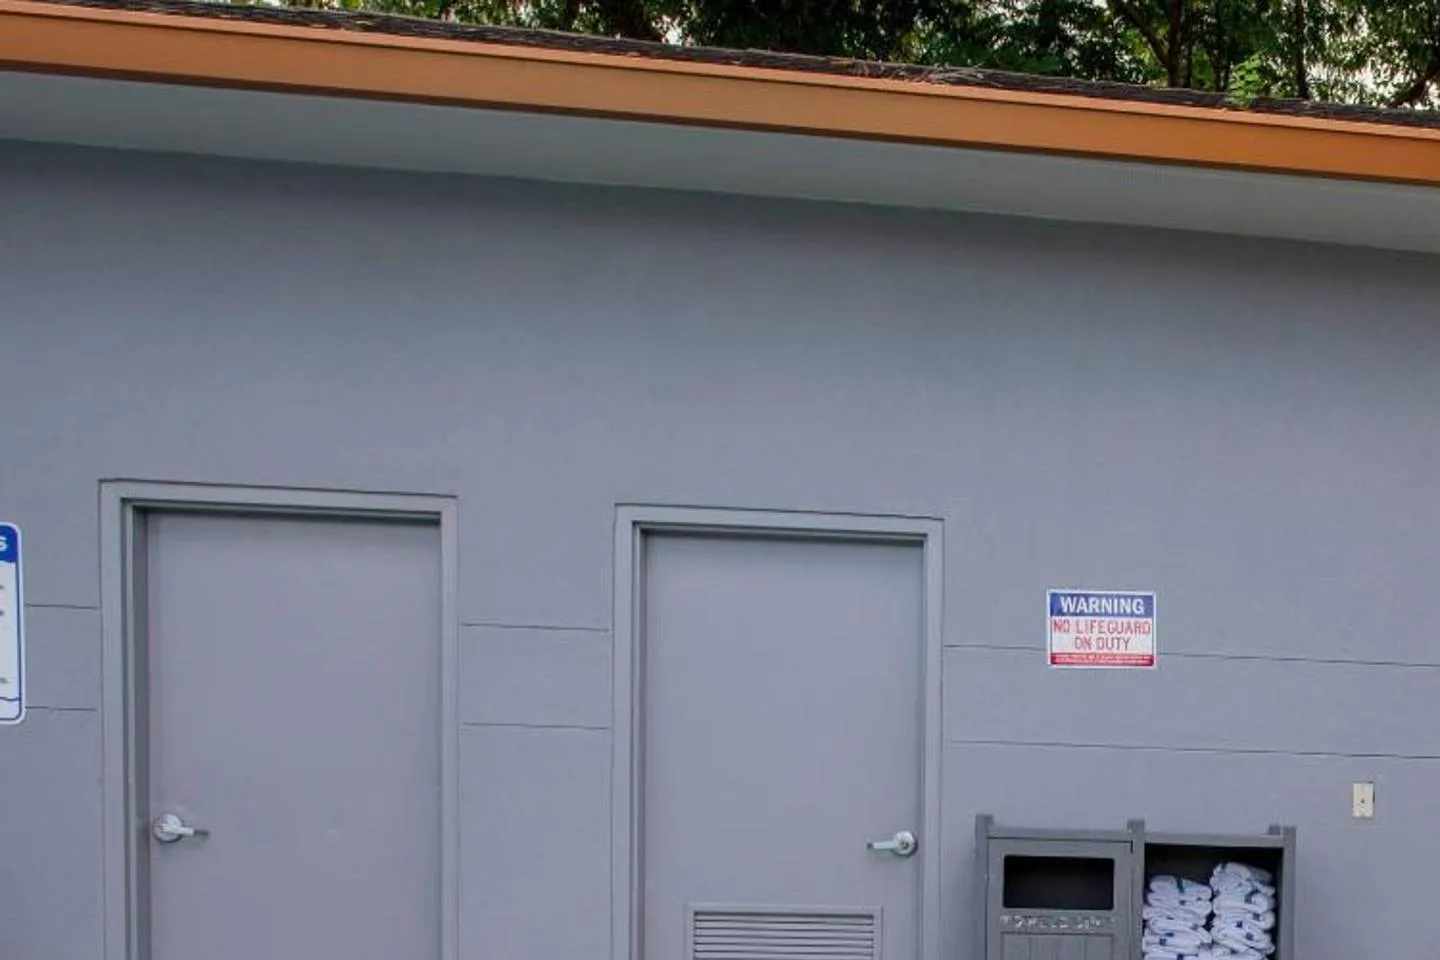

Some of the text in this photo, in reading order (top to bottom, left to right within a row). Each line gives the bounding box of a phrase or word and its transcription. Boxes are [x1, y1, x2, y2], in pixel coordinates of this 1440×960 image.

[1060, 596, 1145, 615] WARNING
[1054, 619, 1151, 635] NO LIFEGUARD
[1075, 636, 1131, 651] ON DUTY
